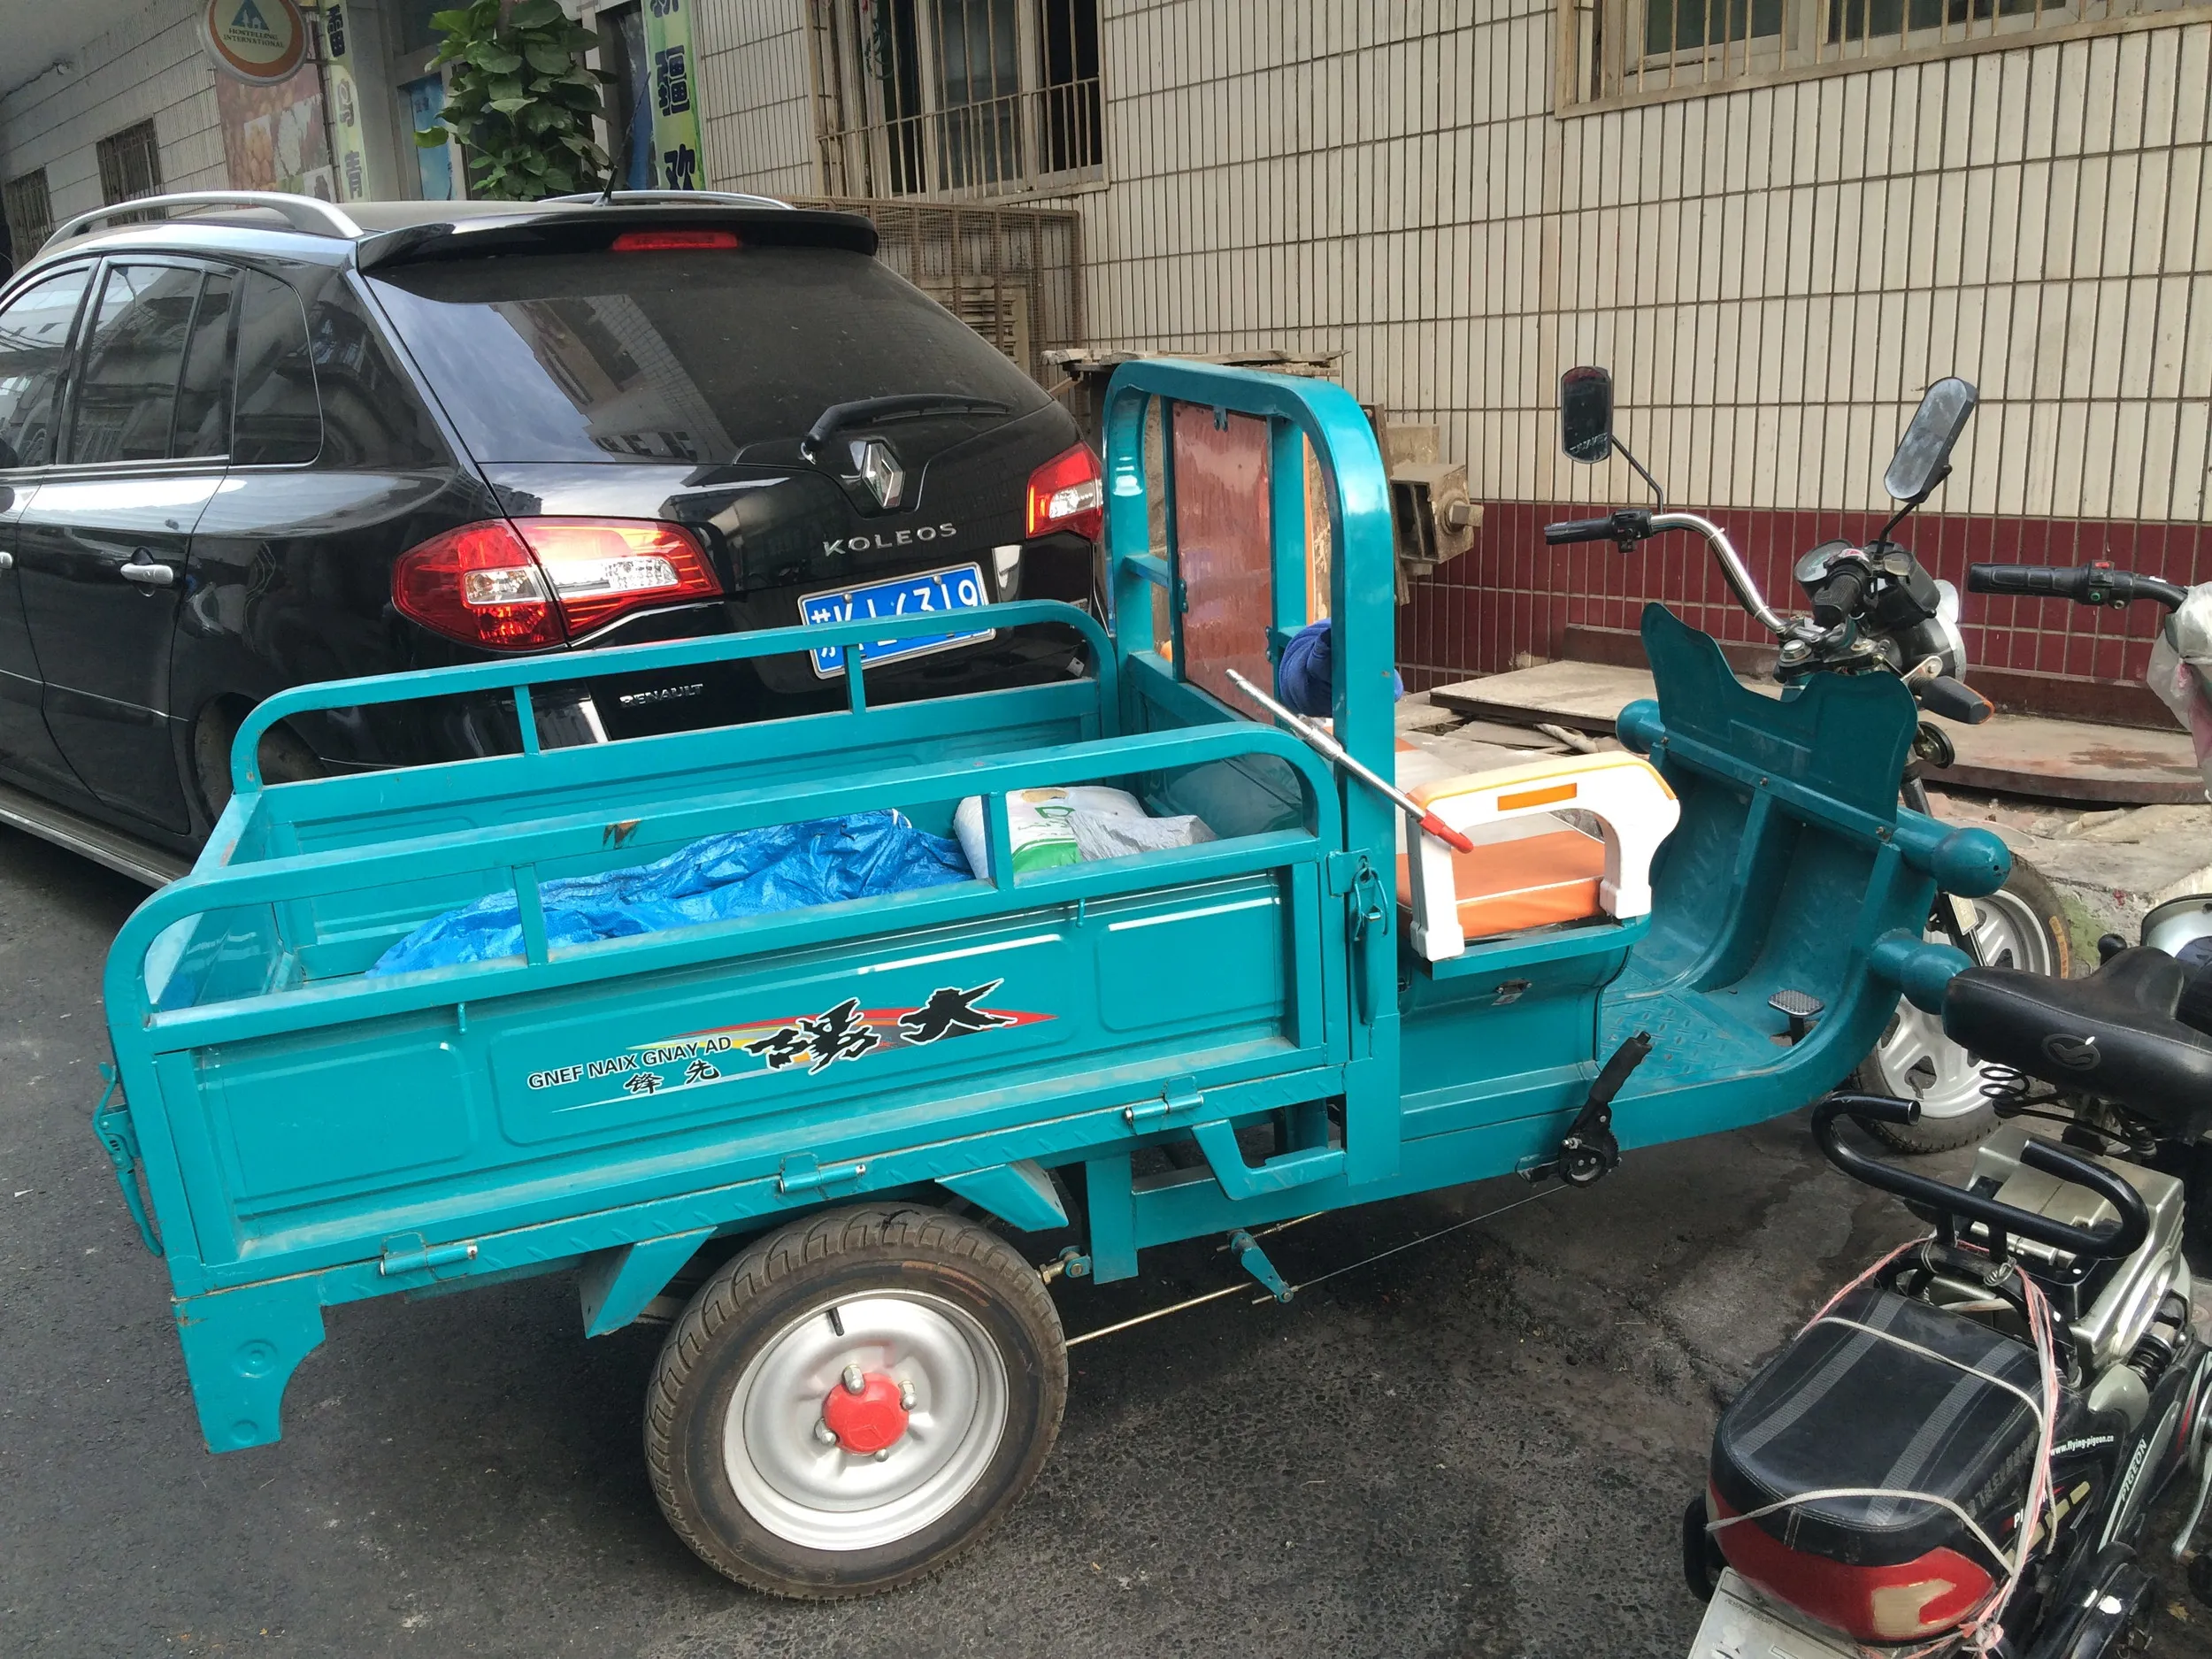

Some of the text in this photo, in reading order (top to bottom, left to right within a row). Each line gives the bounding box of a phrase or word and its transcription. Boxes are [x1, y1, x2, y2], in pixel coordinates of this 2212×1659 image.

[223, 34, 285, 49] INTERNATIONAL
[228, 27, 279, 41] HOSTELLING
[650, 0, 695, 190] 疆欢
[822, 522, 958, 557] KOLEOS
[619, 683, 703, 708] RENAULT
[528, 1036, 733, 1089] GNEF NAIX GNAY AD
[2120, 1440, 2148, 1503] PIGEON
